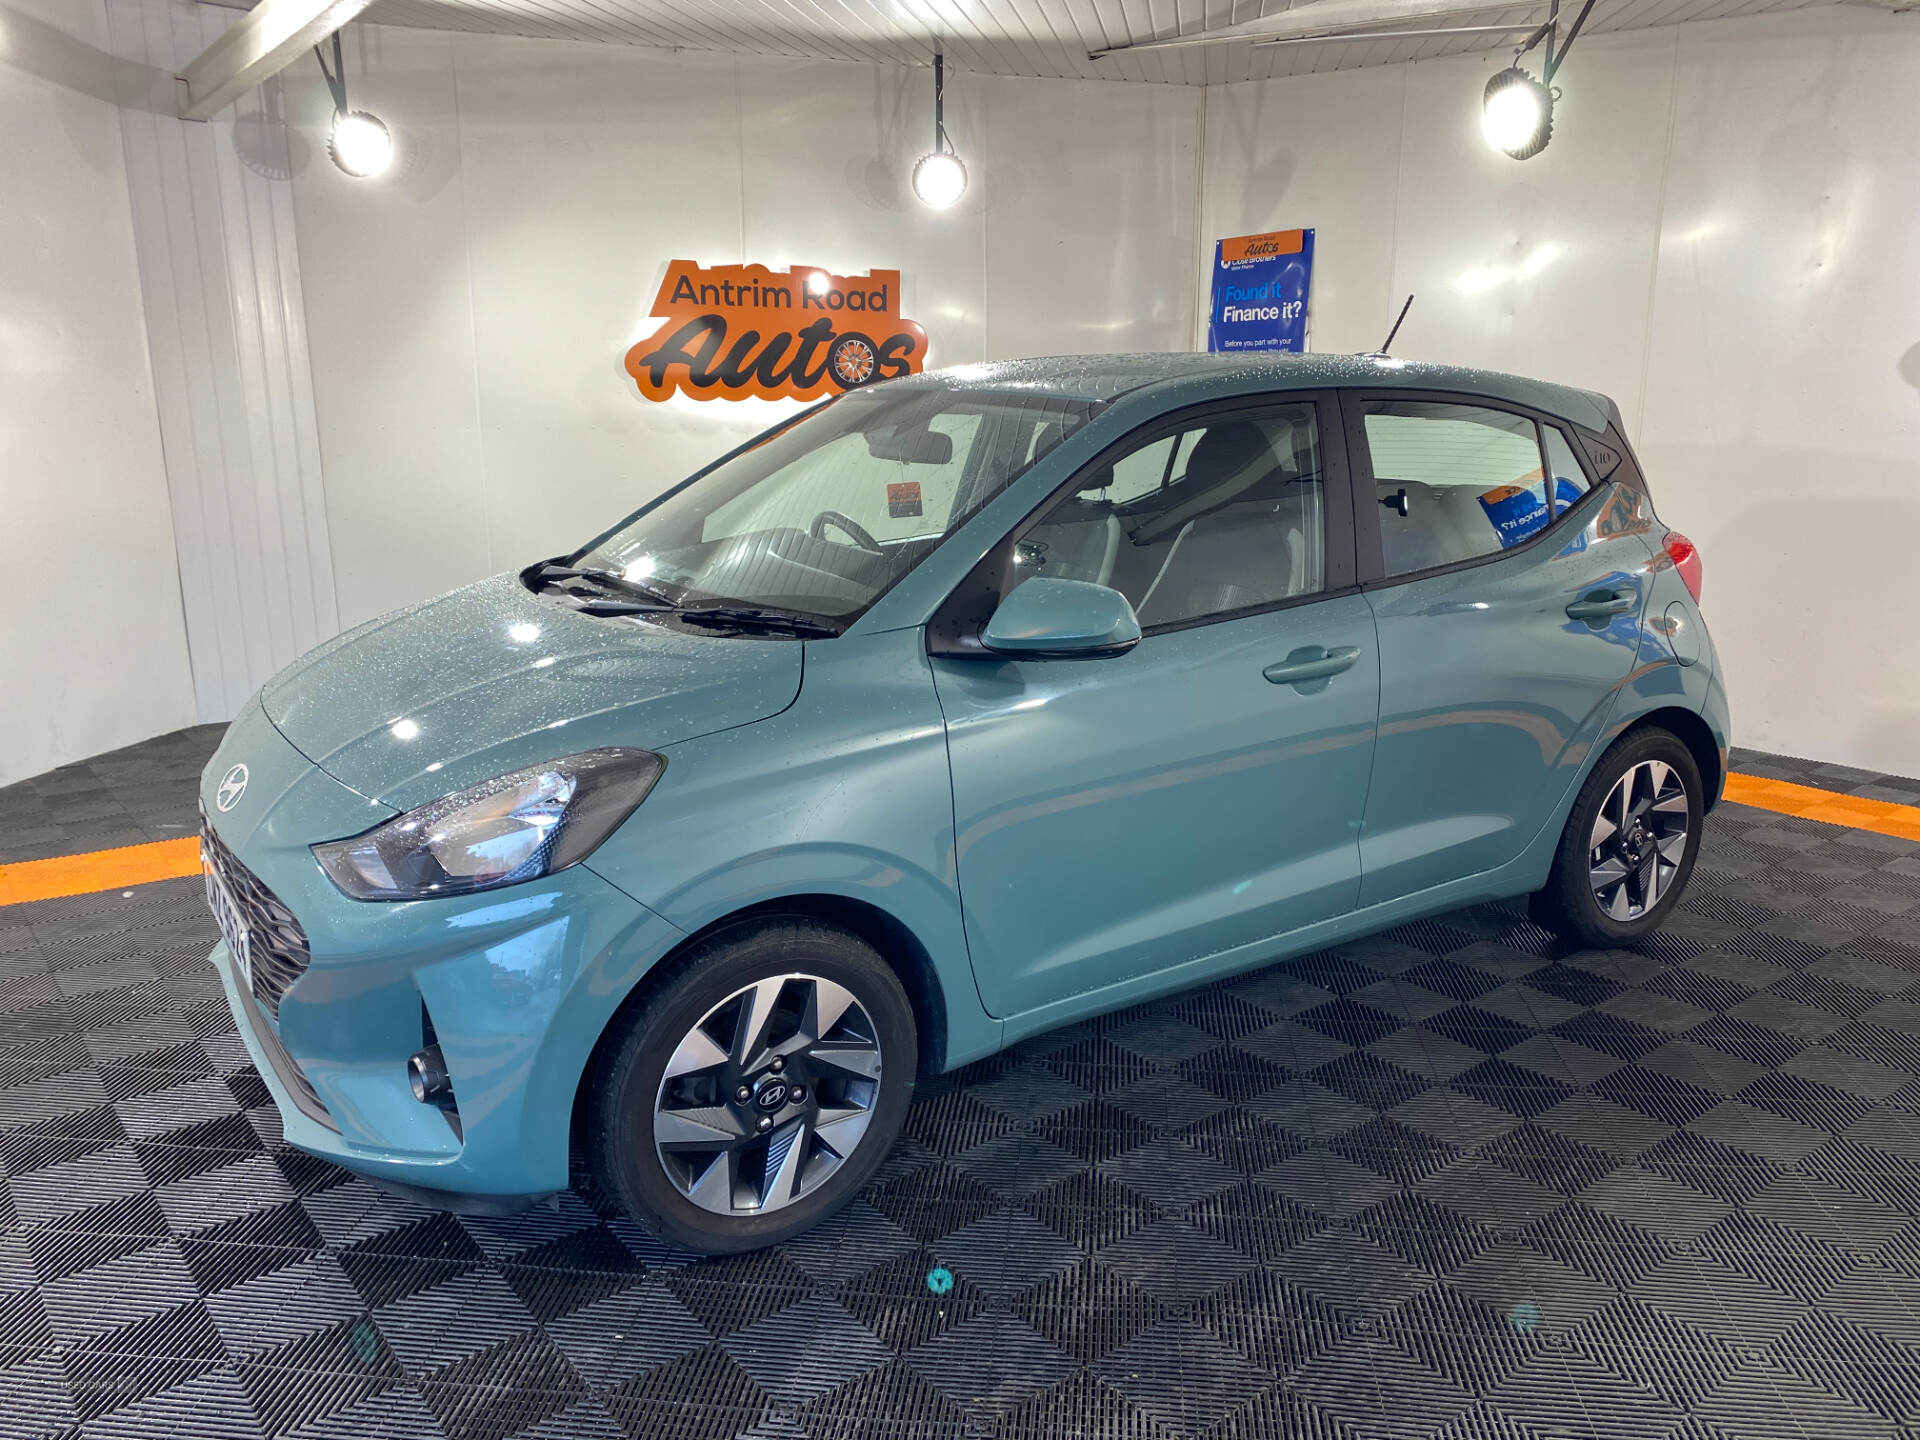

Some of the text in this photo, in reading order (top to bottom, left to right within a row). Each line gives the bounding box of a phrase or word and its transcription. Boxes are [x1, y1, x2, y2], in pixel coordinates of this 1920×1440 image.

[1244, 242, 1280, 256] Autos
[670, 275, 888, 313] Antrim Road
[1225, 282, 1283, 303] Found it
[1223, 300, 1303, 323] Finance it?
[639, 314, 915, 392] Autos
[1224, 340, 1243, 348] Before
[1243, 341, 1254, 349] you
[1254, 339, 1266, 347] part
[1279, 338, 1292, 347] your
